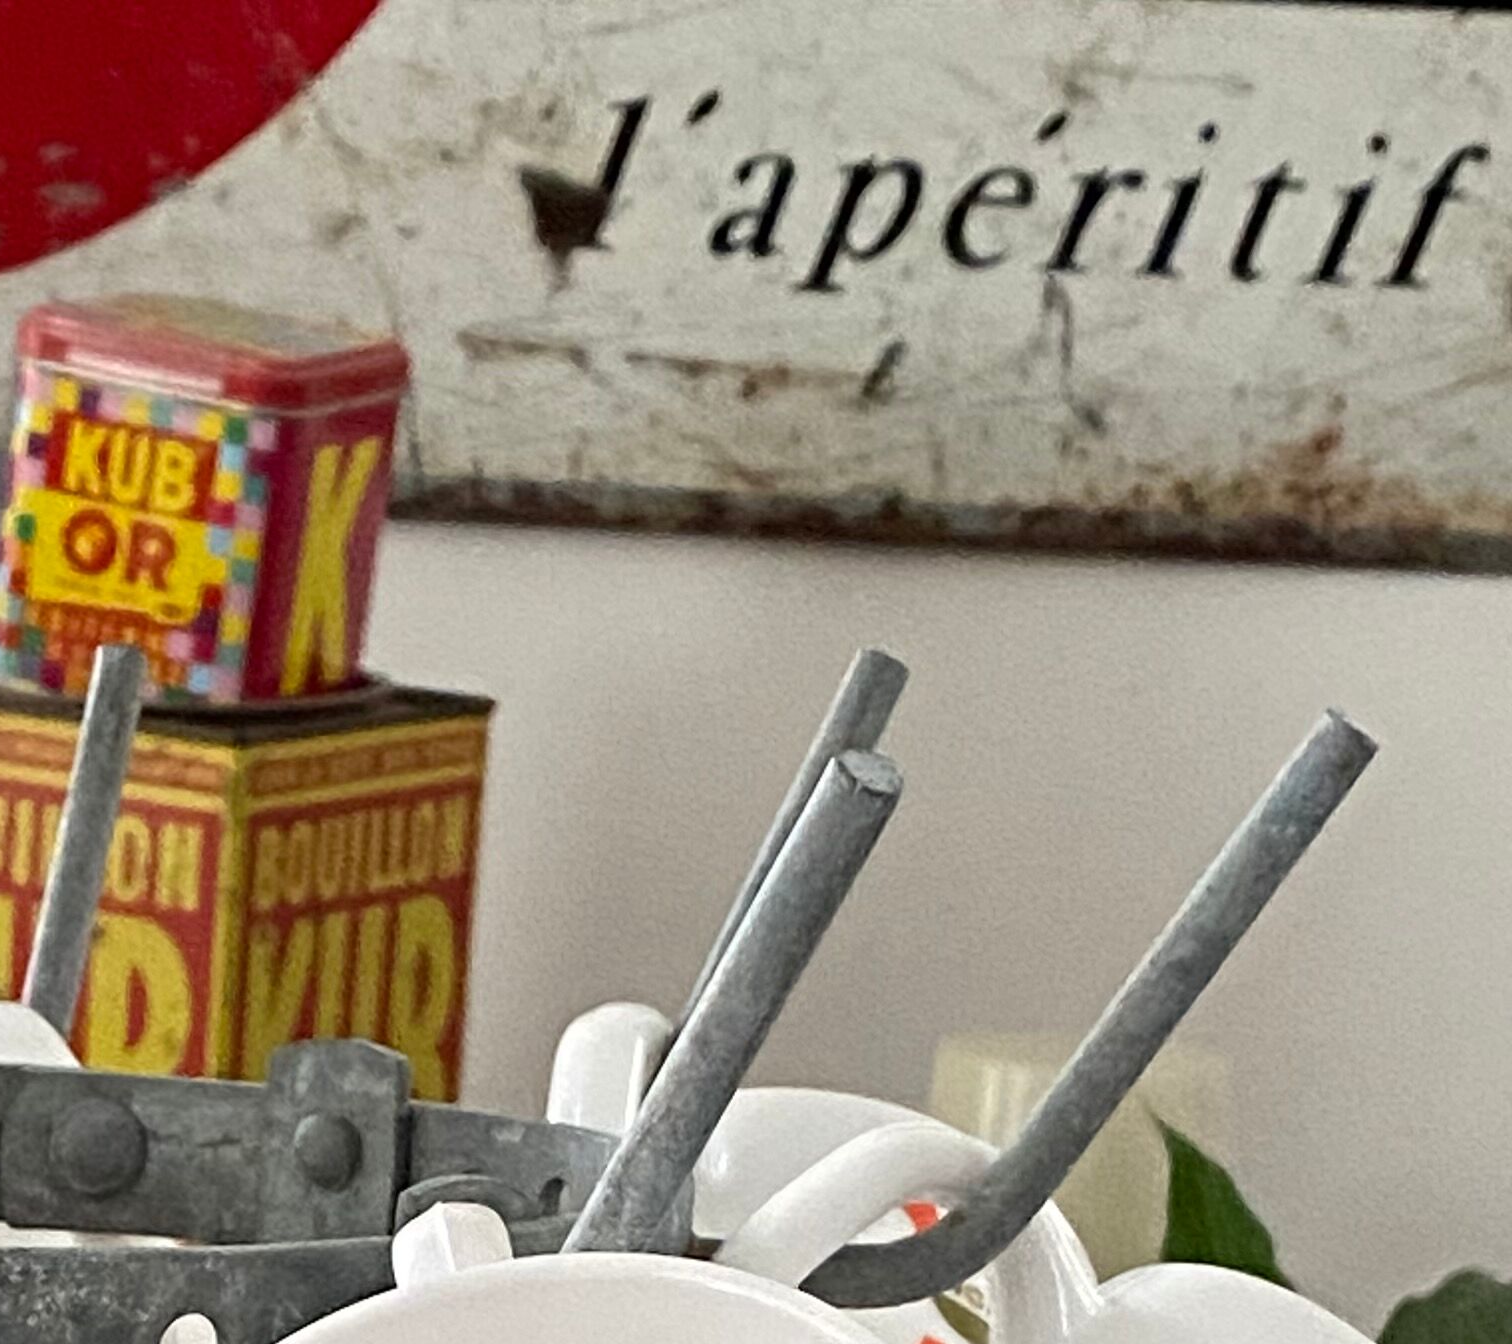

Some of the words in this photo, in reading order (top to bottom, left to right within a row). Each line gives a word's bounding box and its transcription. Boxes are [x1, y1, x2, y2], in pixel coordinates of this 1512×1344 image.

[62, 417, 198, 515] KUB
[61, 507, 177, 592] OR
[279, 436, 386, 696] K
